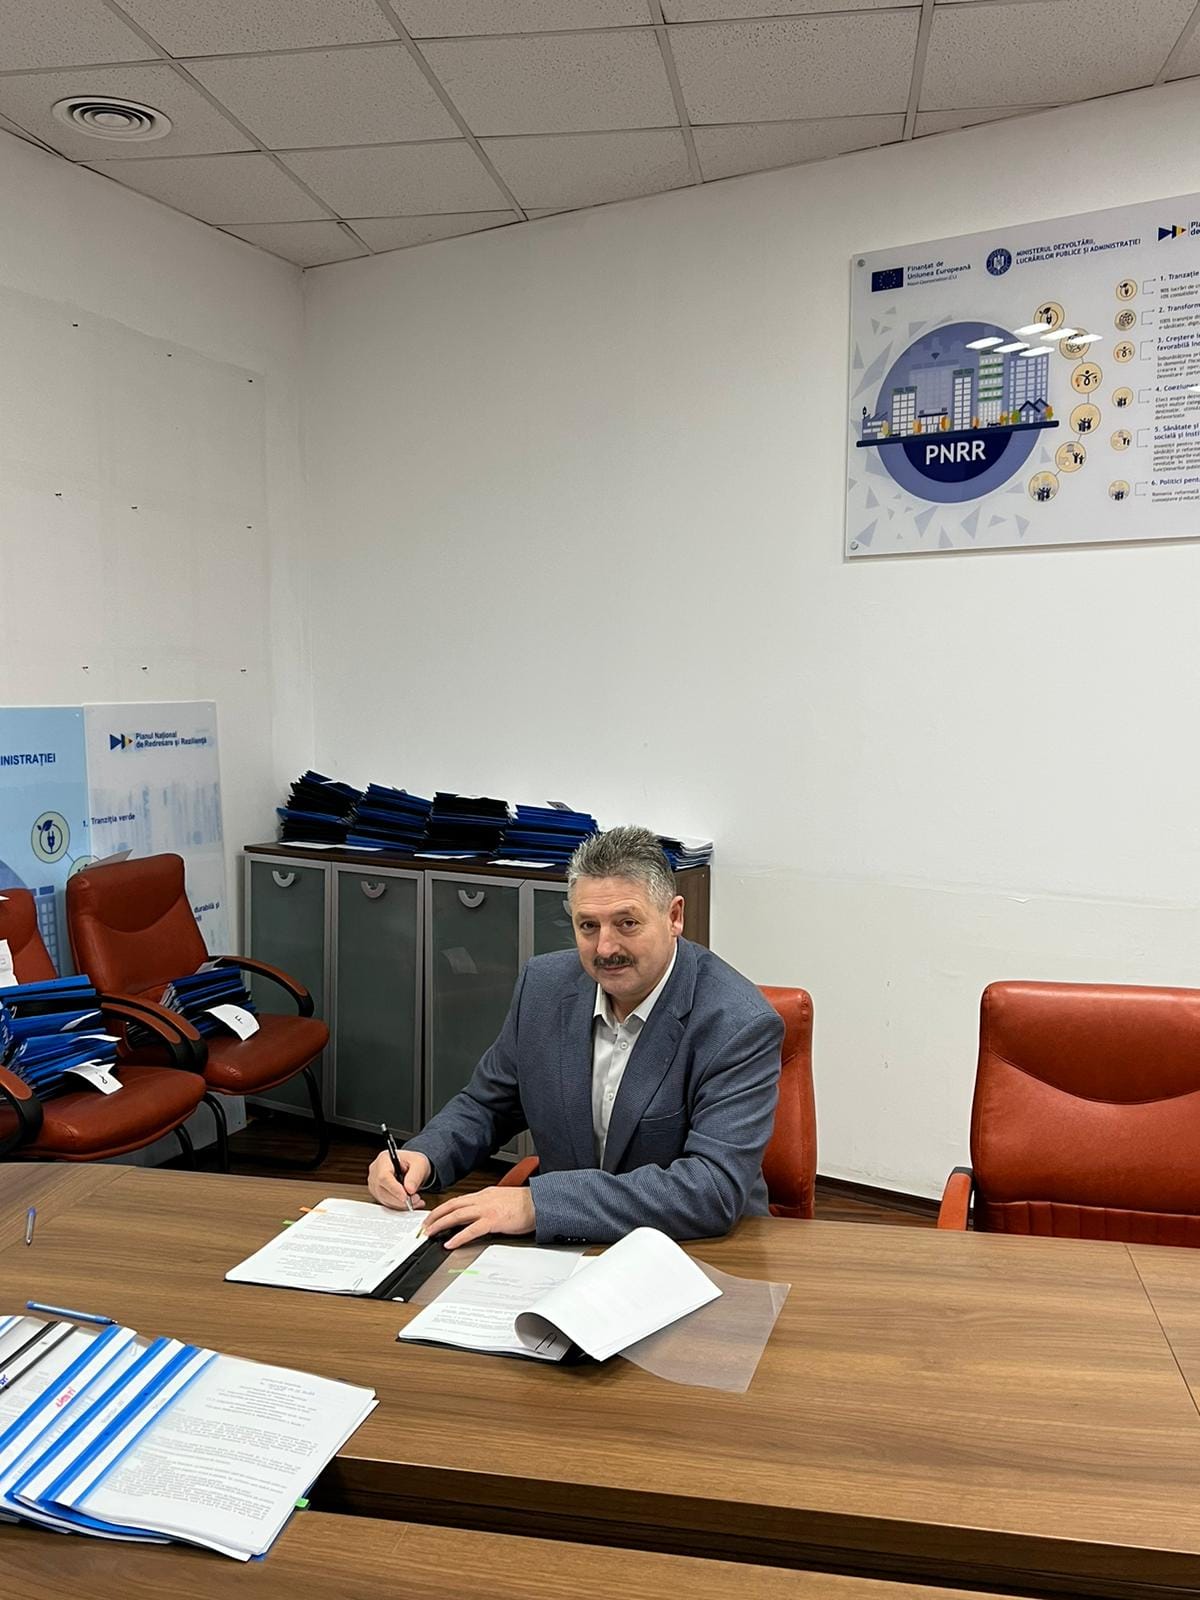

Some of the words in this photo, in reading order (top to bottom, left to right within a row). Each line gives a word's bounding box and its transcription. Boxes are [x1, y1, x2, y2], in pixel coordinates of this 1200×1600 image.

[1015, 252, 1054, 265] LUCRĂRILOR
[1055, 247, 1081, 259] PUBLICE
[1016, 246, 1051, 257] MINISTERUL
[907, 262, 934, 273] Finanțat
[907, 271, 934, 280] Uniunea
[935, 263, 971, 275] Europeană
[1158, 306, 1165, 314] 2.
[1157, 336, 1164, 344] 3.
[1166, 334, 1195, 343] Creștere
[1157, 341, 1190, 351] favorabilă
[1163, 424, 1192, 432] Sănătate
[1154, 431, 1177, 441] socială
[925, 440, 986, 465] PNRR
[1159, 477, 1183, 486] Politici
[136, 732, 154, 740] Planul
[154, 731, 178, 741] Național
[136, 741, 144, 749] de
[144, 740, 174, 749] Redresare
[82, 820, 89, 828] 1.
[91, 815, 118, 826] Tranziția
[119, 812, 136, 822] verde
